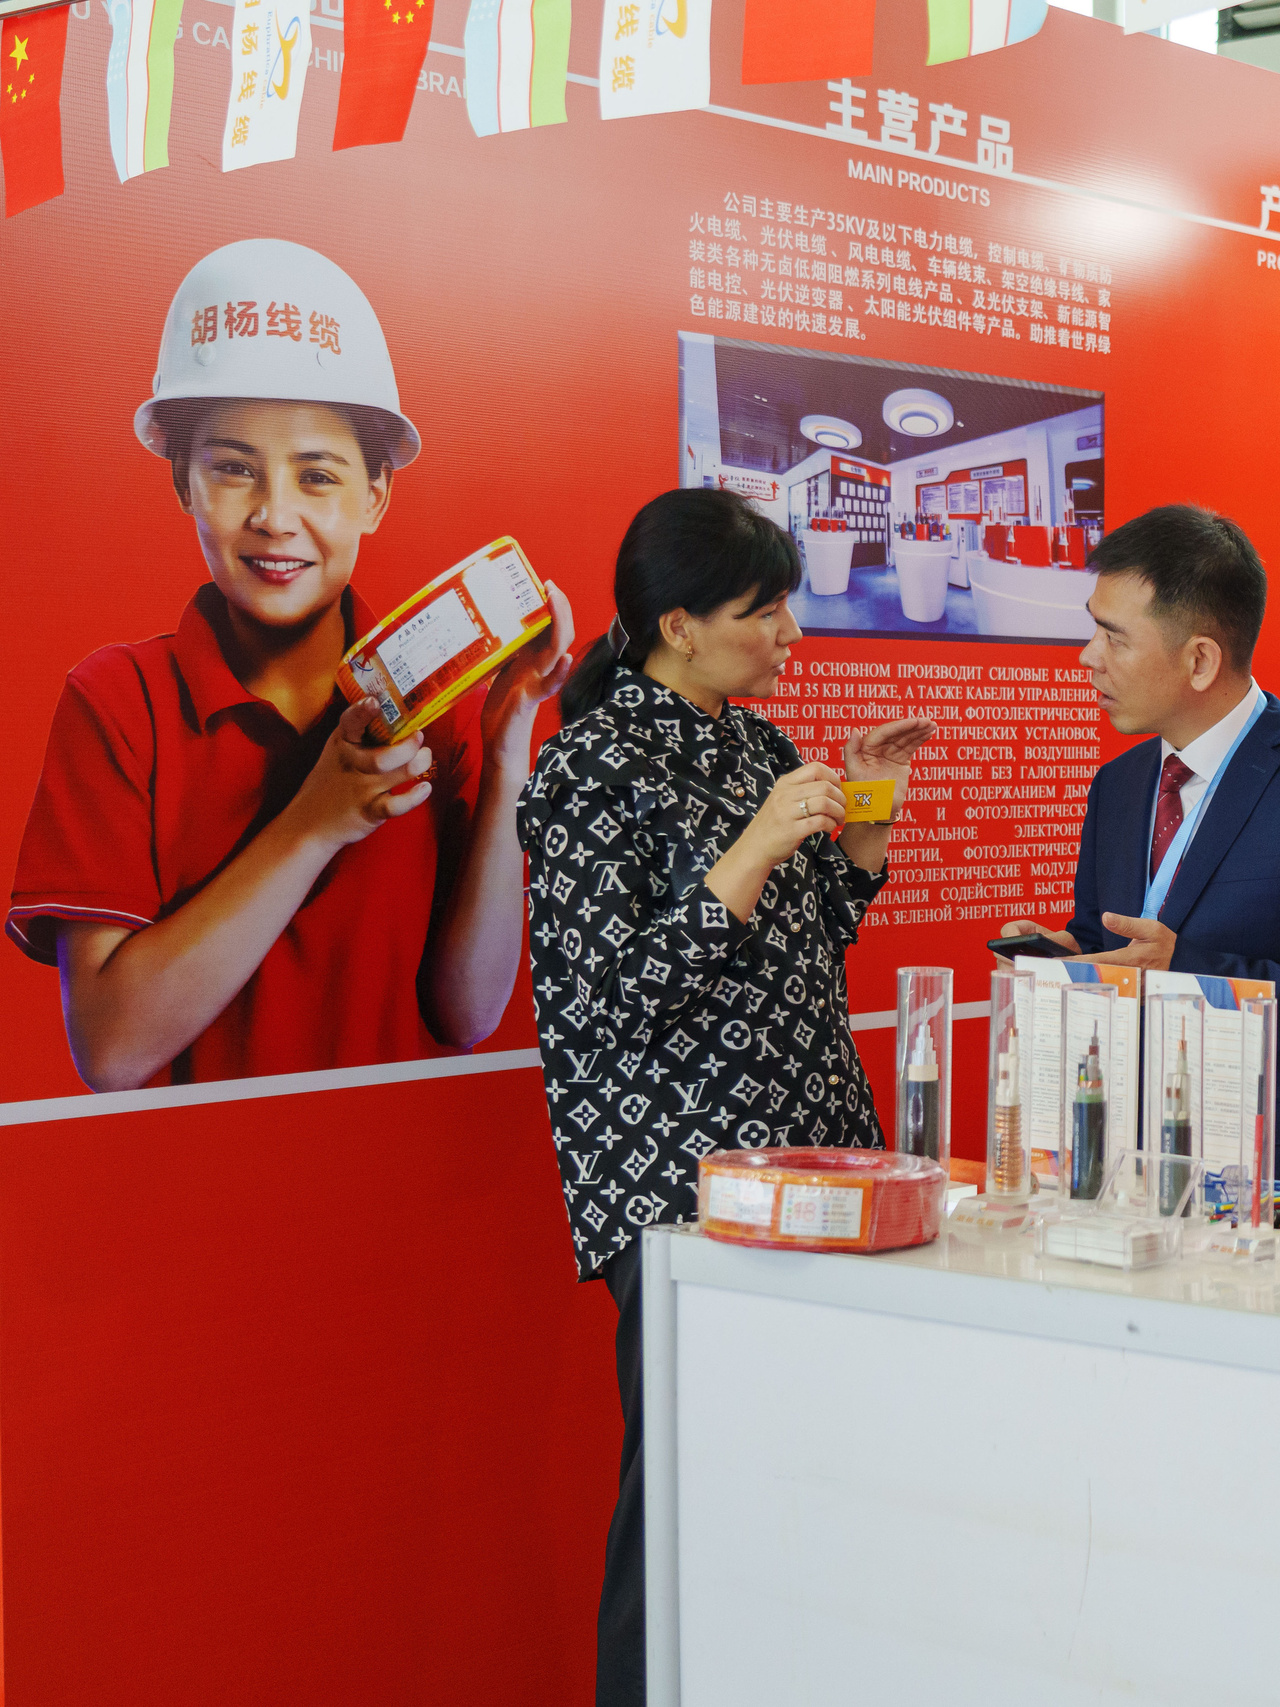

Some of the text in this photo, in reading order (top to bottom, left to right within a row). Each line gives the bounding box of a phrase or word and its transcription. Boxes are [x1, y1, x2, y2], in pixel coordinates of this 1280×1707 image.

[825, 77, 1014, 175] 主营产品
[848, 159, 991, 207] MAIN PRODUCTS
[190, 299, 342, 357] 胡杨线缆
[794, 661, 1093, 683] В ОСНОВНОМ ПРОИЗВОДИТ СИЛОВЫЕ КАБЕЛ
[804, 682, 1098, 701] 35 КВ И НИЖЕ, А ТАКЖЕ КАБЕЛИ УПРАВЛЕНИЯ
[802, 702, 1100, 722] ОГНЕСТОЙКИЕ КАБЕЛИ, ФОТОЭЛЕКТРИЧЕСКИЕ
[822, 725, 847, 742] ДЛЯ
[1024, 726, 1100, 741] УСТАНОВОК,
[956, 746, 1100, 761] СРЕДСТВ, ВОЗДУШНЫЕ
[991, 765, 1012, 779] БЕЗ
[905, 786, 952, 801] ИЗКИМ
[960, 785, 1055, 801] СОДЕРЖАНИЕМ
[936, 806, 945, 821] И
[889, 826, 978, 842] ЕКТУАЛЬНОЕ
[886, 847, 943, 863] НЕРГИИ,
[888, 864, 1021, 883] ОТОЭЛЕКТРИЧЕСКИЕ
[940, 883, 1024, 901] СОДЕЙСТВИЕ
[1034, 880, 1074, 895] БЫСТР
[892, 899, 1075, 924] ЗЕЛЕНОЙ ЭНЕРГЕТИКИ В МИР
